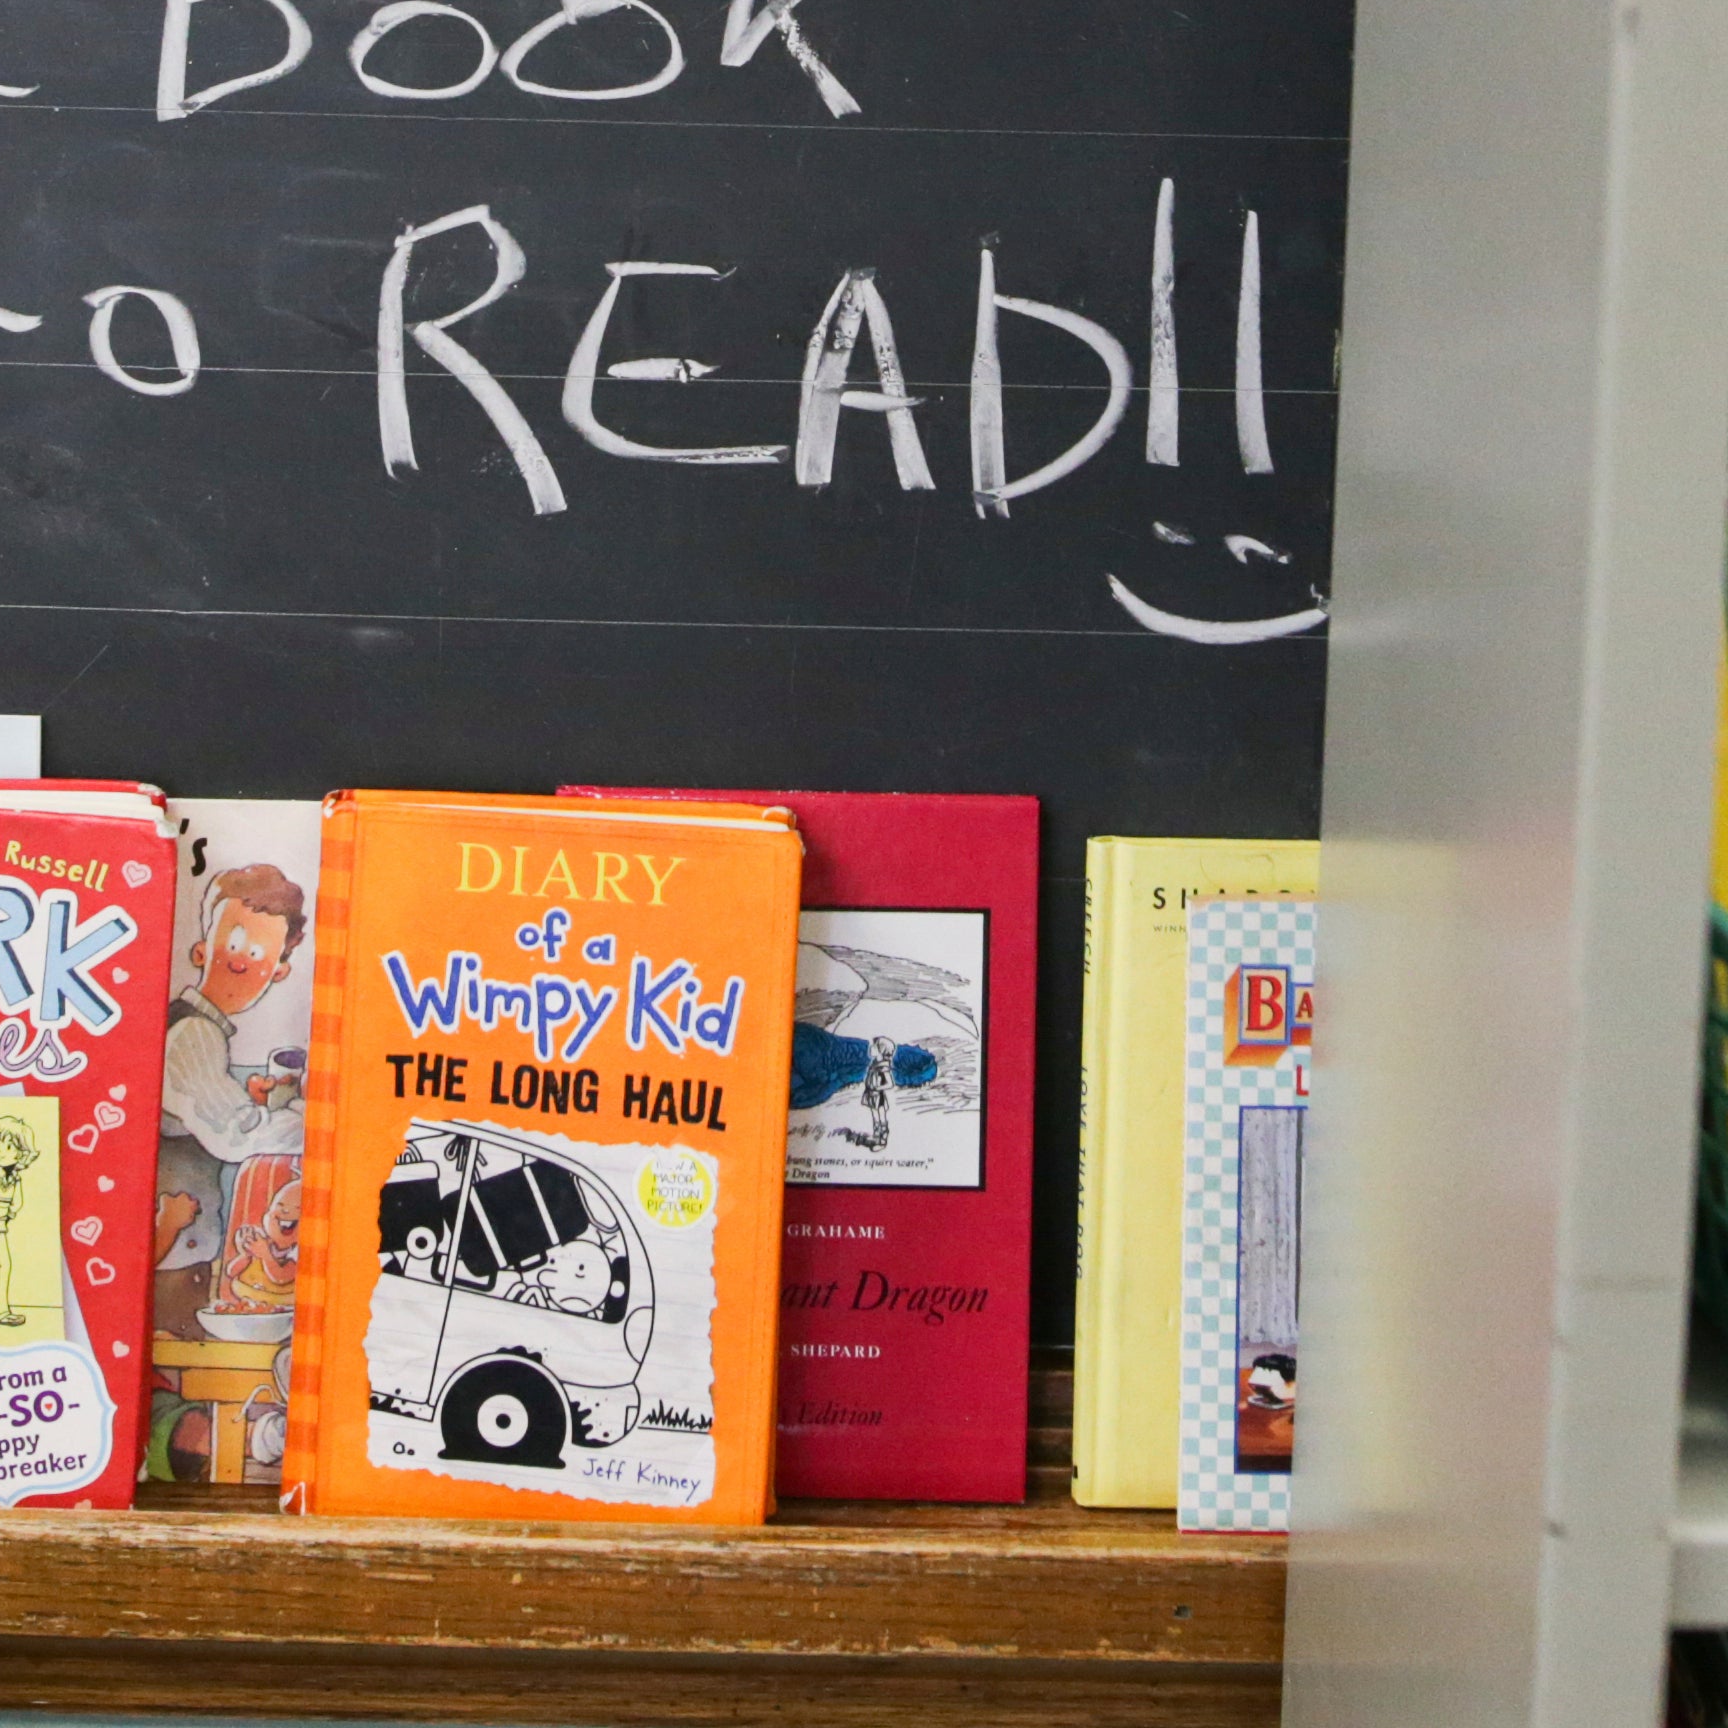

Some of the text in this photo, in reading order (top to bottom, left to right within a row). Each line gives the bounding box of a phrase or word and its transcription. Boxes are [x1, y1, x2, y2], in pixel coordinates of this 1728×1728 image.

[4, 840, 109, 892] Russell
[455, 841, 687, 906] DIARY
[517, 909, 613, 962] of a
[387, 954, 739, 1059] Wimpy Kid
[387, 1054, 727, 1131] THE LONG HAUL
[791, 1169, 830, 1181] Dragon
[815, 1157, 848, 1168] stones,
[851, 1159, 861, 1167] or
[651, 1187, 699, 1200] MOTION
[787, 1224, 885, 1239] GRAHAME
[851, 1270, 989, 1327] Dragon
[790, 1344, 881, 1359] SHEPARD
[52, 1366, 67, 1383] a
[582, 1458, 701, 1502] Jeff Kinney
